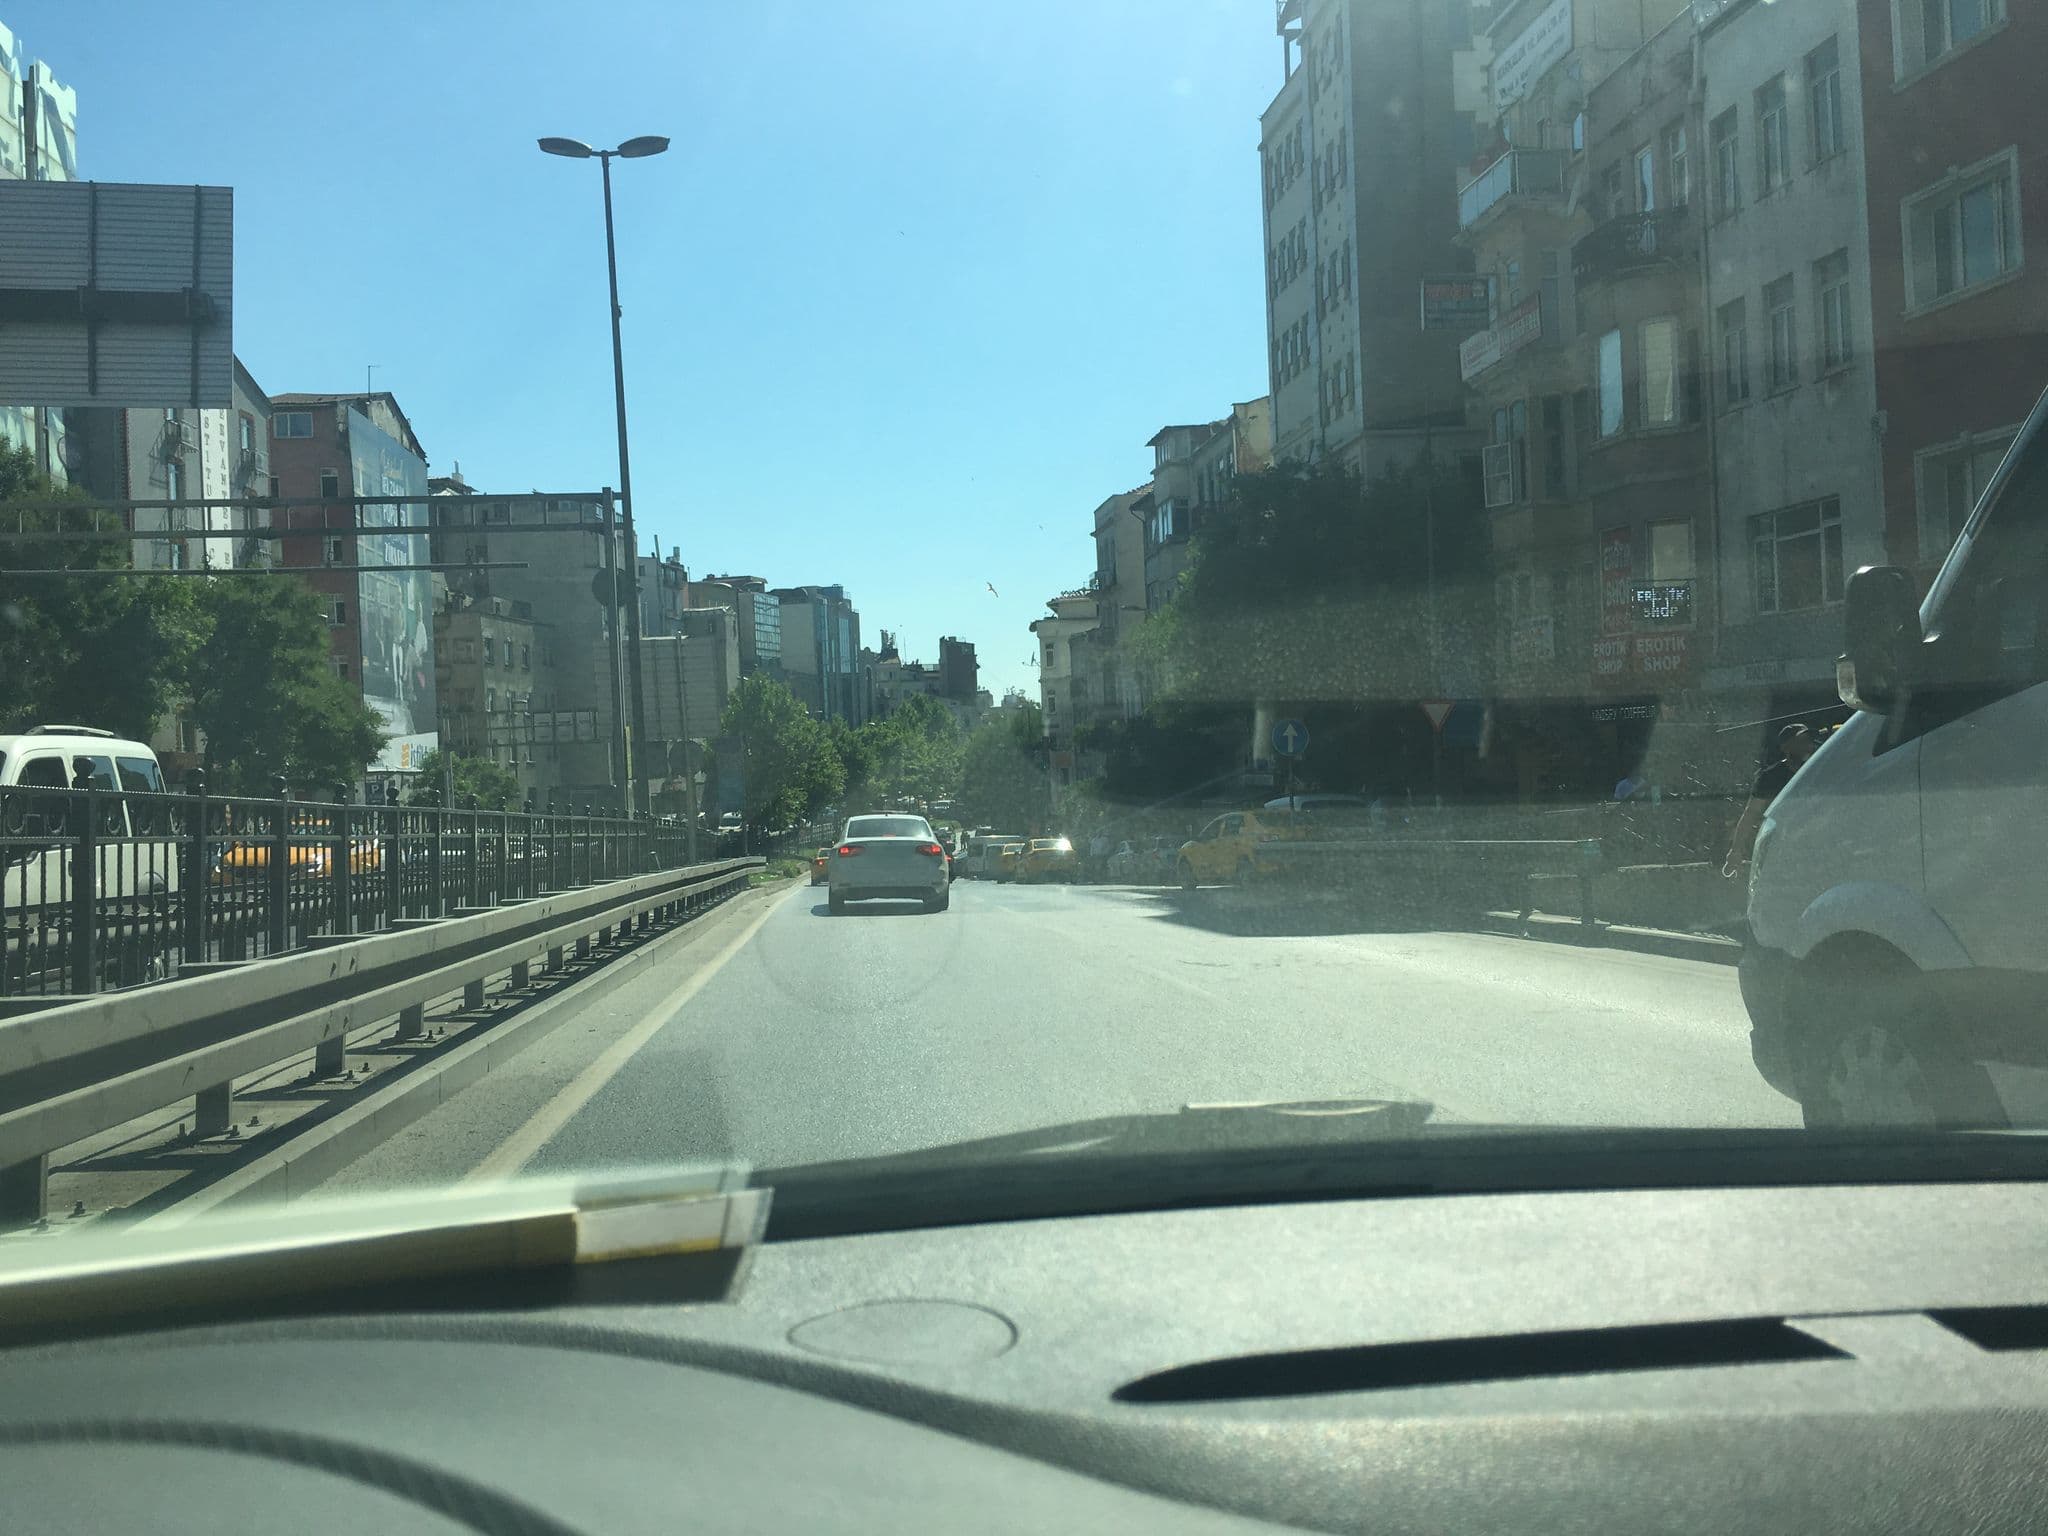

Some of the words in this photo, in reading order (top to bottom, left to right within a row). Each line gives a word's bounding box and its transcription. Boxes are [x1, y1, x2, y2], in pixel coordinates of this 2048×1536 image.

[1636, 634, 1686, 654] EROTİK
[1598, 658, 1623, 673] SHOP
[1643, 655, 1681, 672] SHOP
